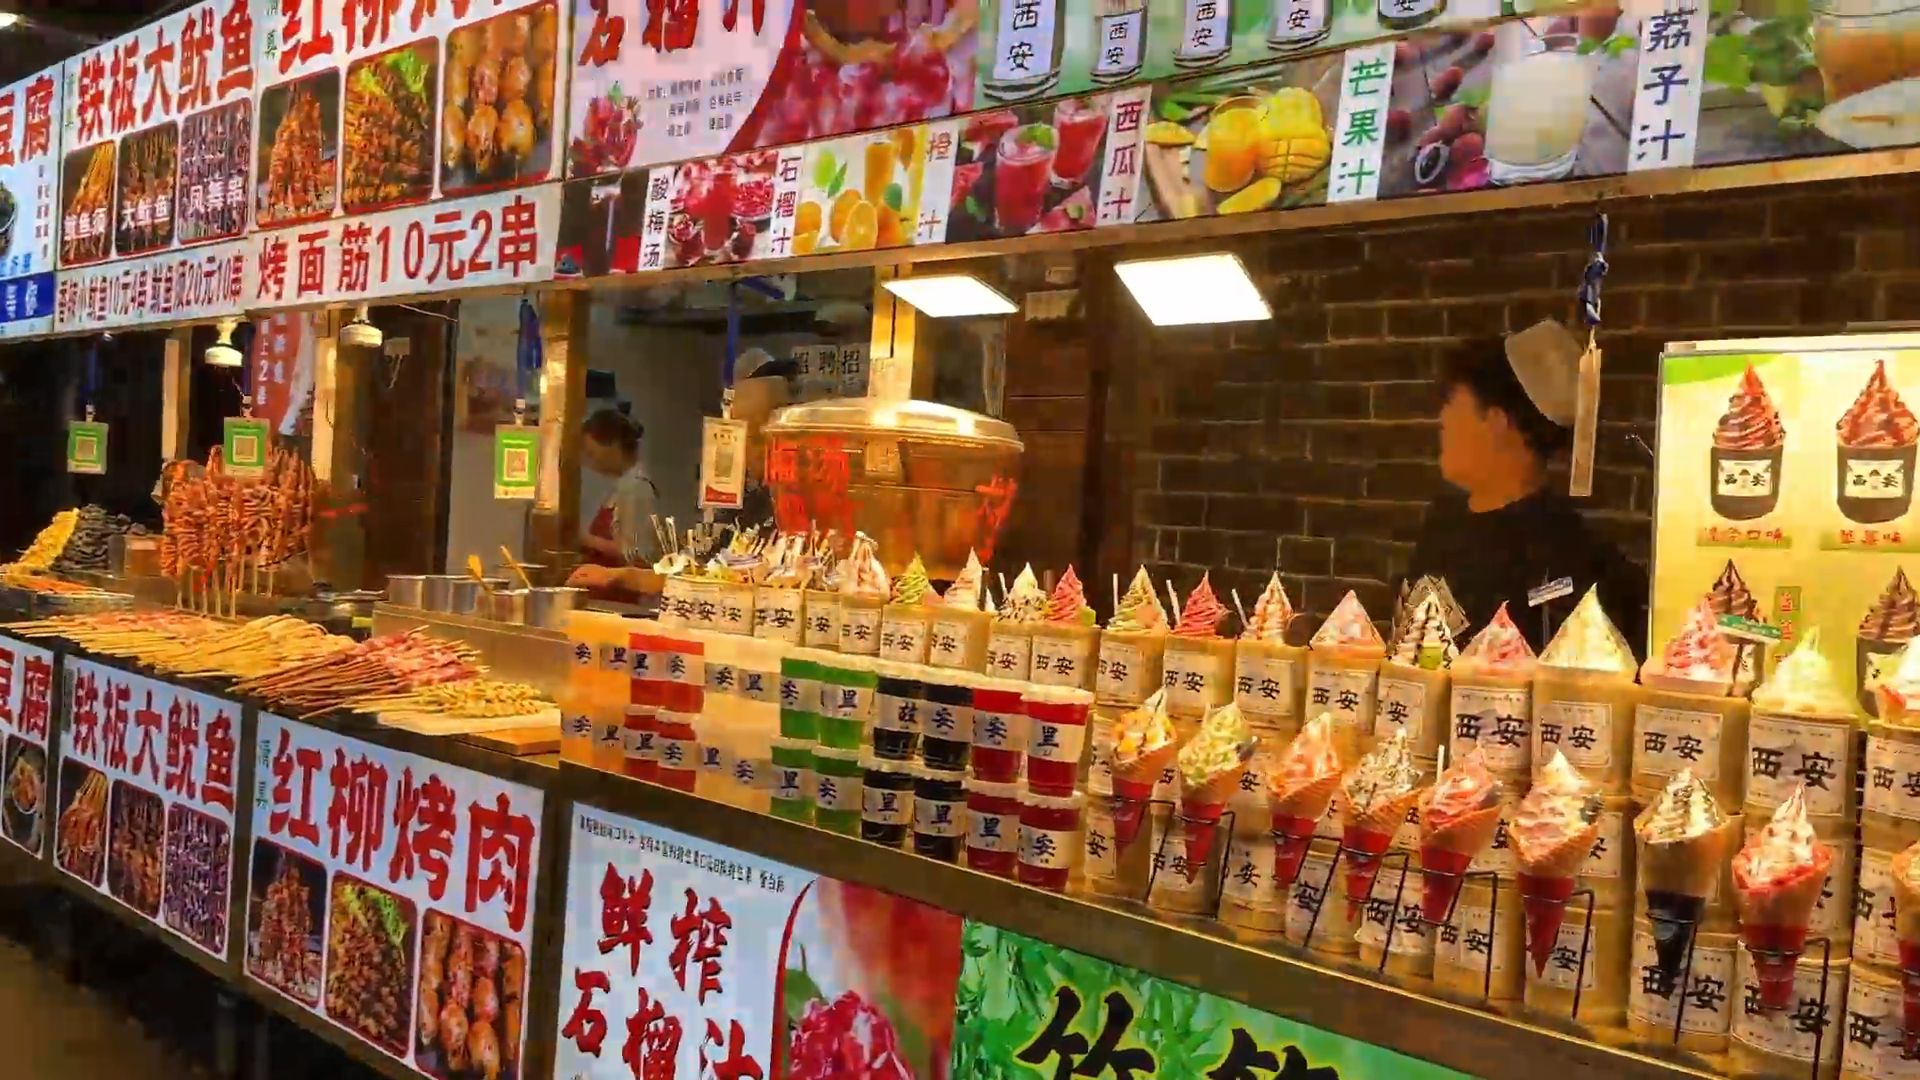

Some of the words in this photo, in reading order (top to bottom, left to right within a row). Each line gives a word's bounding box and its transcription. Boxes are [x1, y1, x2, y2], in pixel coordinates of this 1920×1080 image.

[1006, 1, 1038, 72] 西安
[1105, 22, 1128, 65] 西安
[1286, 0, 1312, 29] 安
[77, 0, 254, 143] 铁板大鱿鱼
[1636, 8, 1697, 163] 荔子汁
[1101, 100, 1145, 220] 西瓜汁
[1337, 59, 1388, 196] 芒果汁
[643, 173, 671, 268] 酸梅汤
[771, 156, 801, 254] 石榴汁
[918, 131, 952, 241] 橙汁
[257, 195, 538, 300] 烤面筋10元2串
[1036, 653, 1075, 676] 西安
[1165, 669, 1205, 693] 西安
[1237, 675, 1282, 701] 西安
[1312, 687, 1360, 713] 西安
[73, 667, 237, 813] 铁板大鱿鱼
[1037, 725, 1060, 749] 里
[1456, 712, 1530, 748] 西安
[1540, 722, 1597, 751] 西安
[1643, 731, 1704, 763] 西安
[1752, 746, 1836, 792] 西安
[269, 728, 535, 932] 红柳烤肉
[599, 861, 733, 1006] 鲜榨
